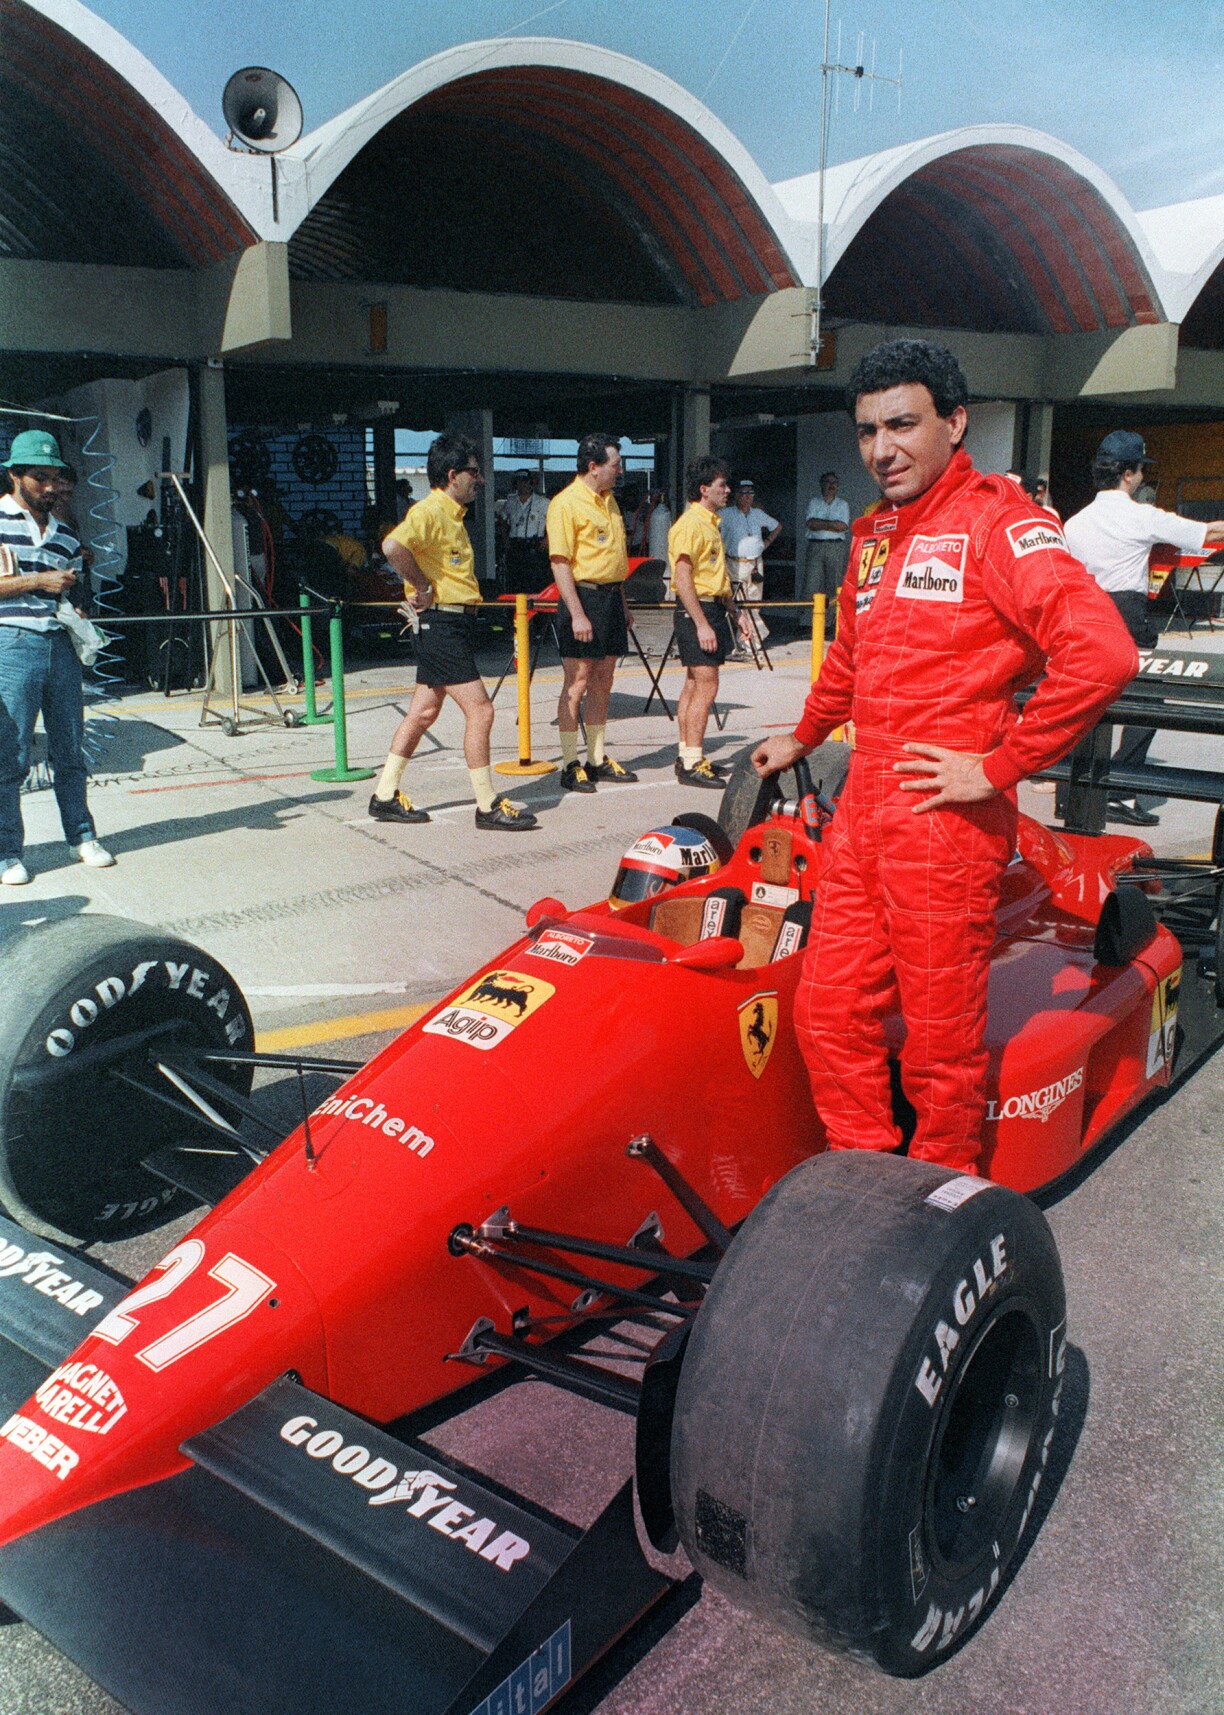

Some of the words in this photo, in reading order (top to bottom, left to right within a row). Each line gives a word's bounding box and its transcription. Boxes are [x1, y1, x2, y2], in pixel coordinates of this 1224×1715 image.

[902, 566, 958, 593] Marlboro
[529, 943, 578, 964] Marlboro
[547, 931, 585, 946] ALBORETO
[432, 1009, 498, 1041] Agip
[985, 1066, 1084, 1121] LONGINES
[91, 1238, 278, 1374] 27
[915, 1233, 1008, 1407] EAGLE
